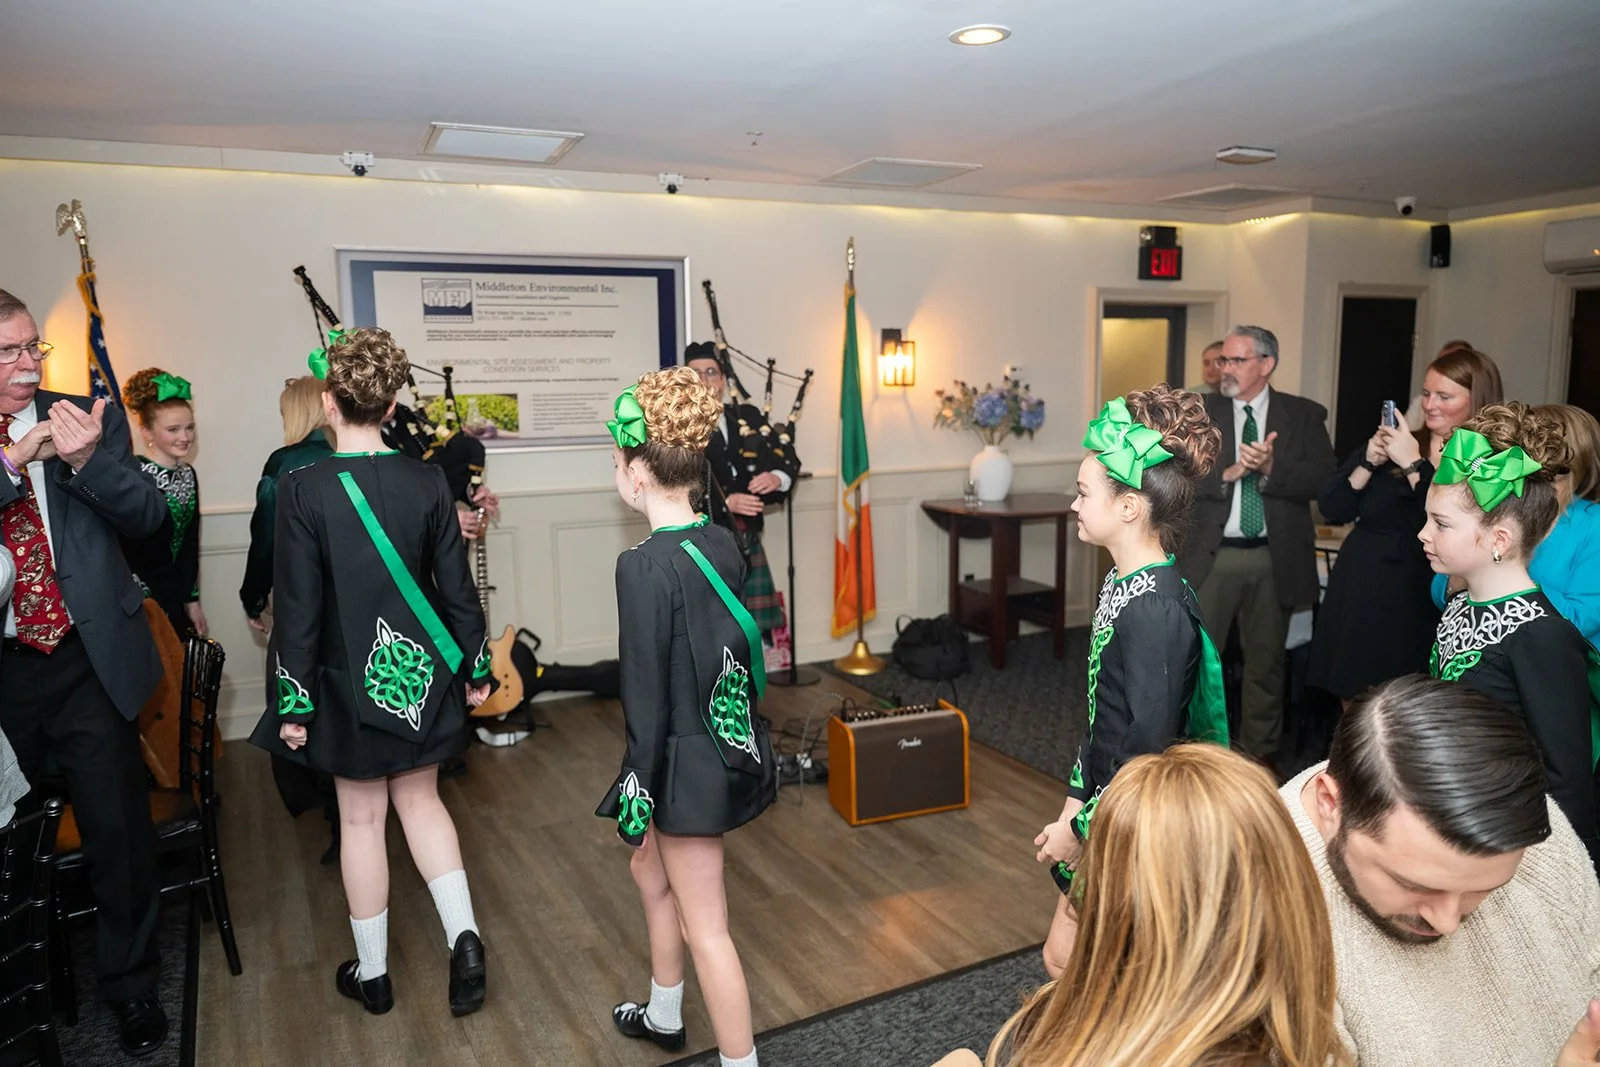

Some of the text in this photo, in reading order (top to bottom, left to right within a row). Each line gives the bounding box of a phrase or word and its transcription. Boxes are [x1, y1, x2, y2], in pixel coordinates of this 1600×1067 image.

[475, 281, 619, 294] Middleton Environmental Inc.
